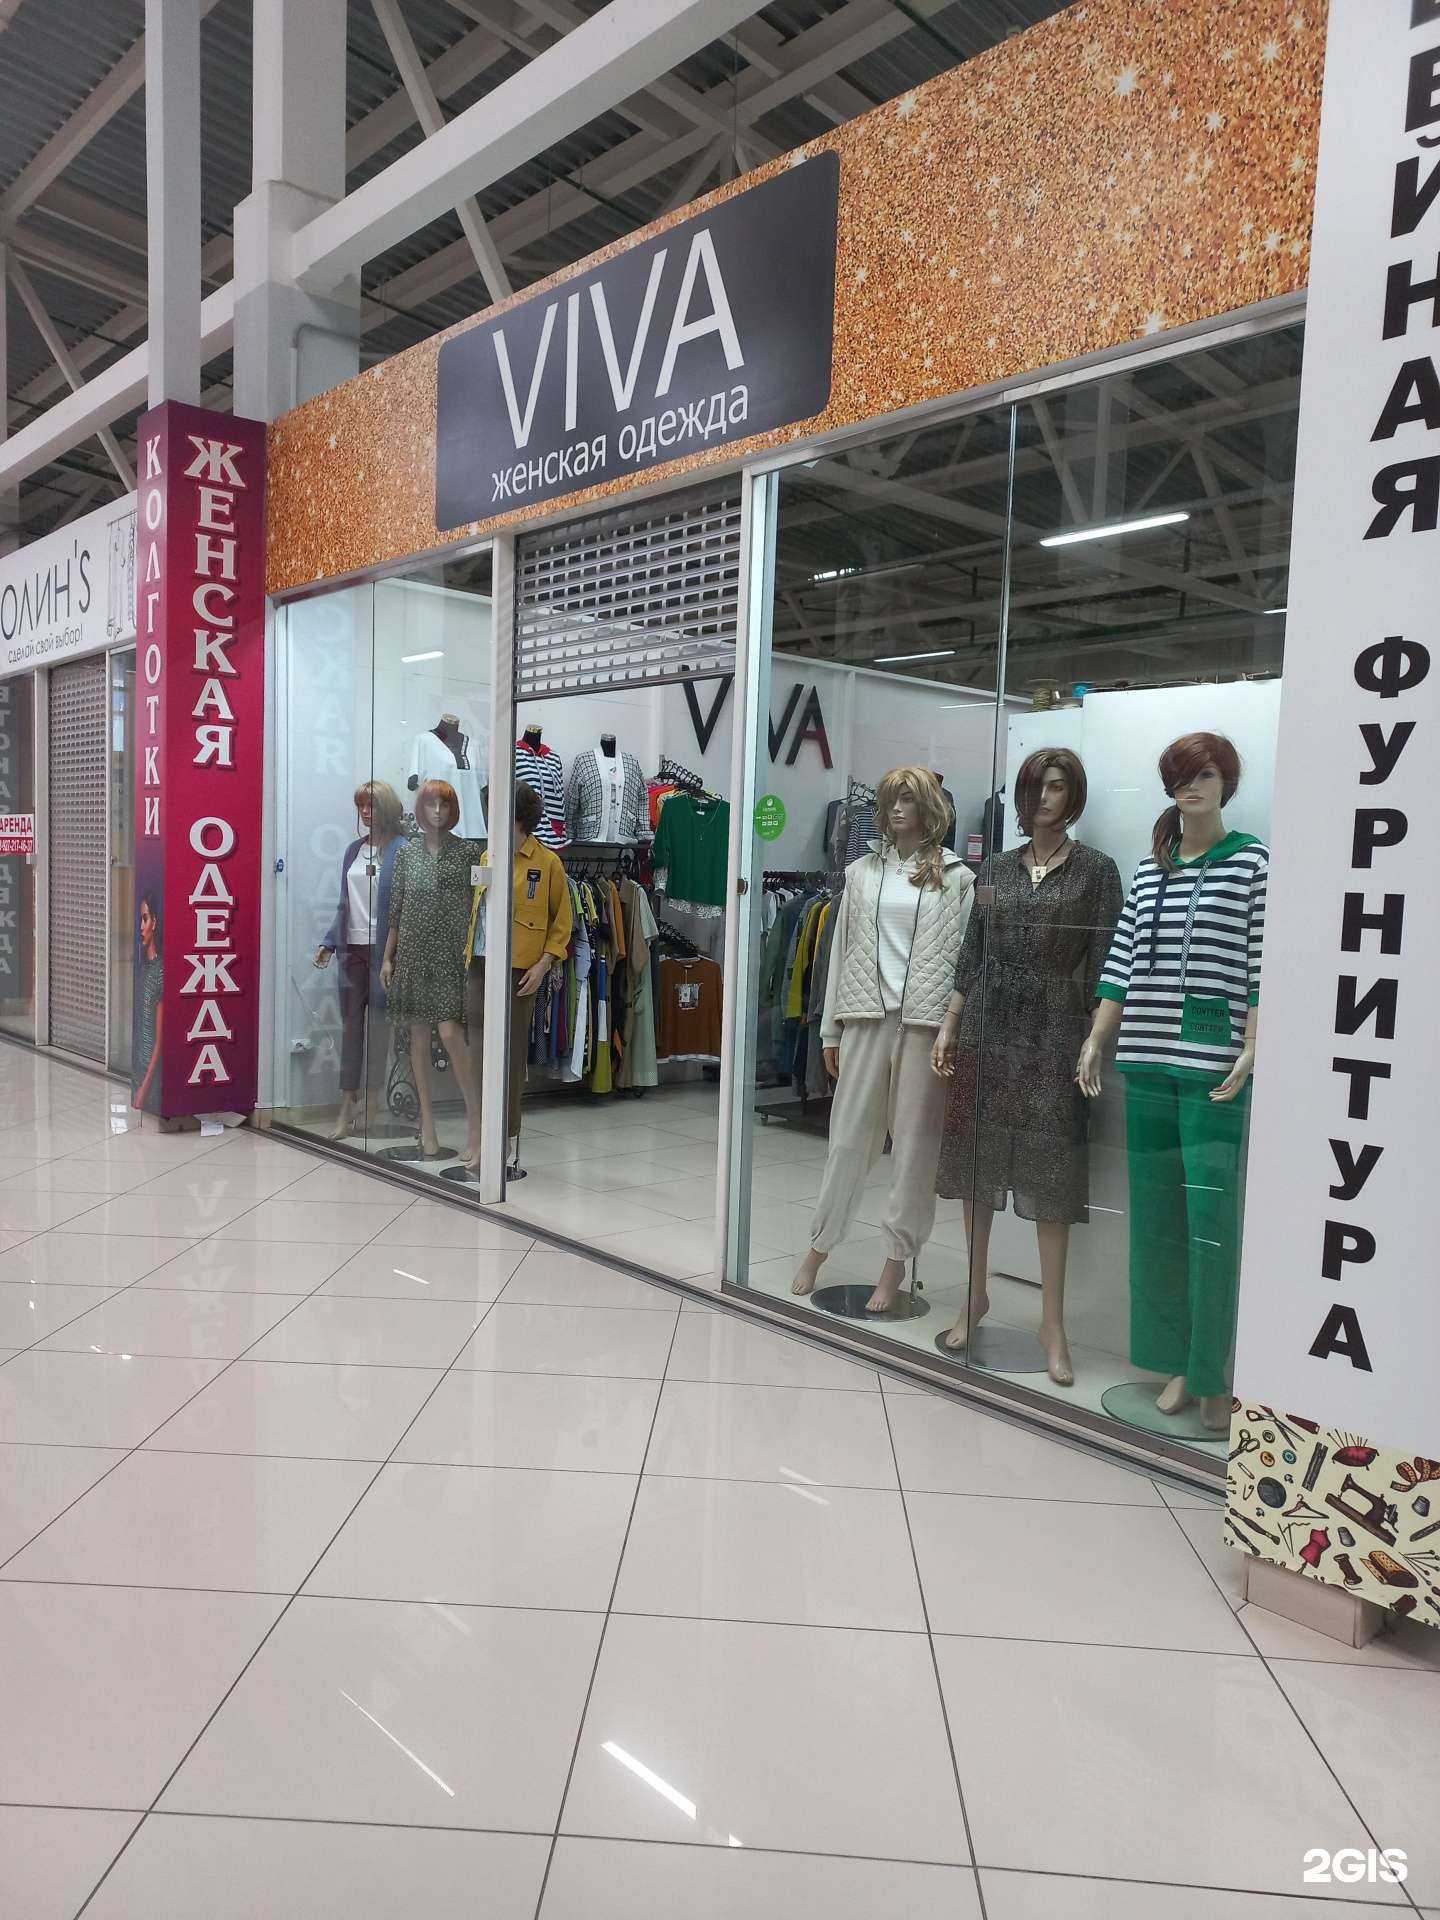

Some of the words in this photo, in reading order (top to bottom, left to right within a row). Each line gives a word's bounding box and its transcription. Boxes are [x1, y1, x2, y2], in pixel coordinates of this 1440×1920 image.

[491, 434, 607, 503] женская
[618, 383, 749, 461] одежда
[492, 228, 745, 450] VIVA
[35, 632, 55, 655] свой
[144, 434, 162, 836] КОЛГОТКИ
[184, 434, 247, 767] ЖЕНСКАЯ
[0, 816, 33, 836] АРЕНДА
[682, 664, 833, 769] VVA
[179, 815, 241, 1085] ОДЕЖДА
[1308, 635, 1432, 1373] ФУРНИТУРА
